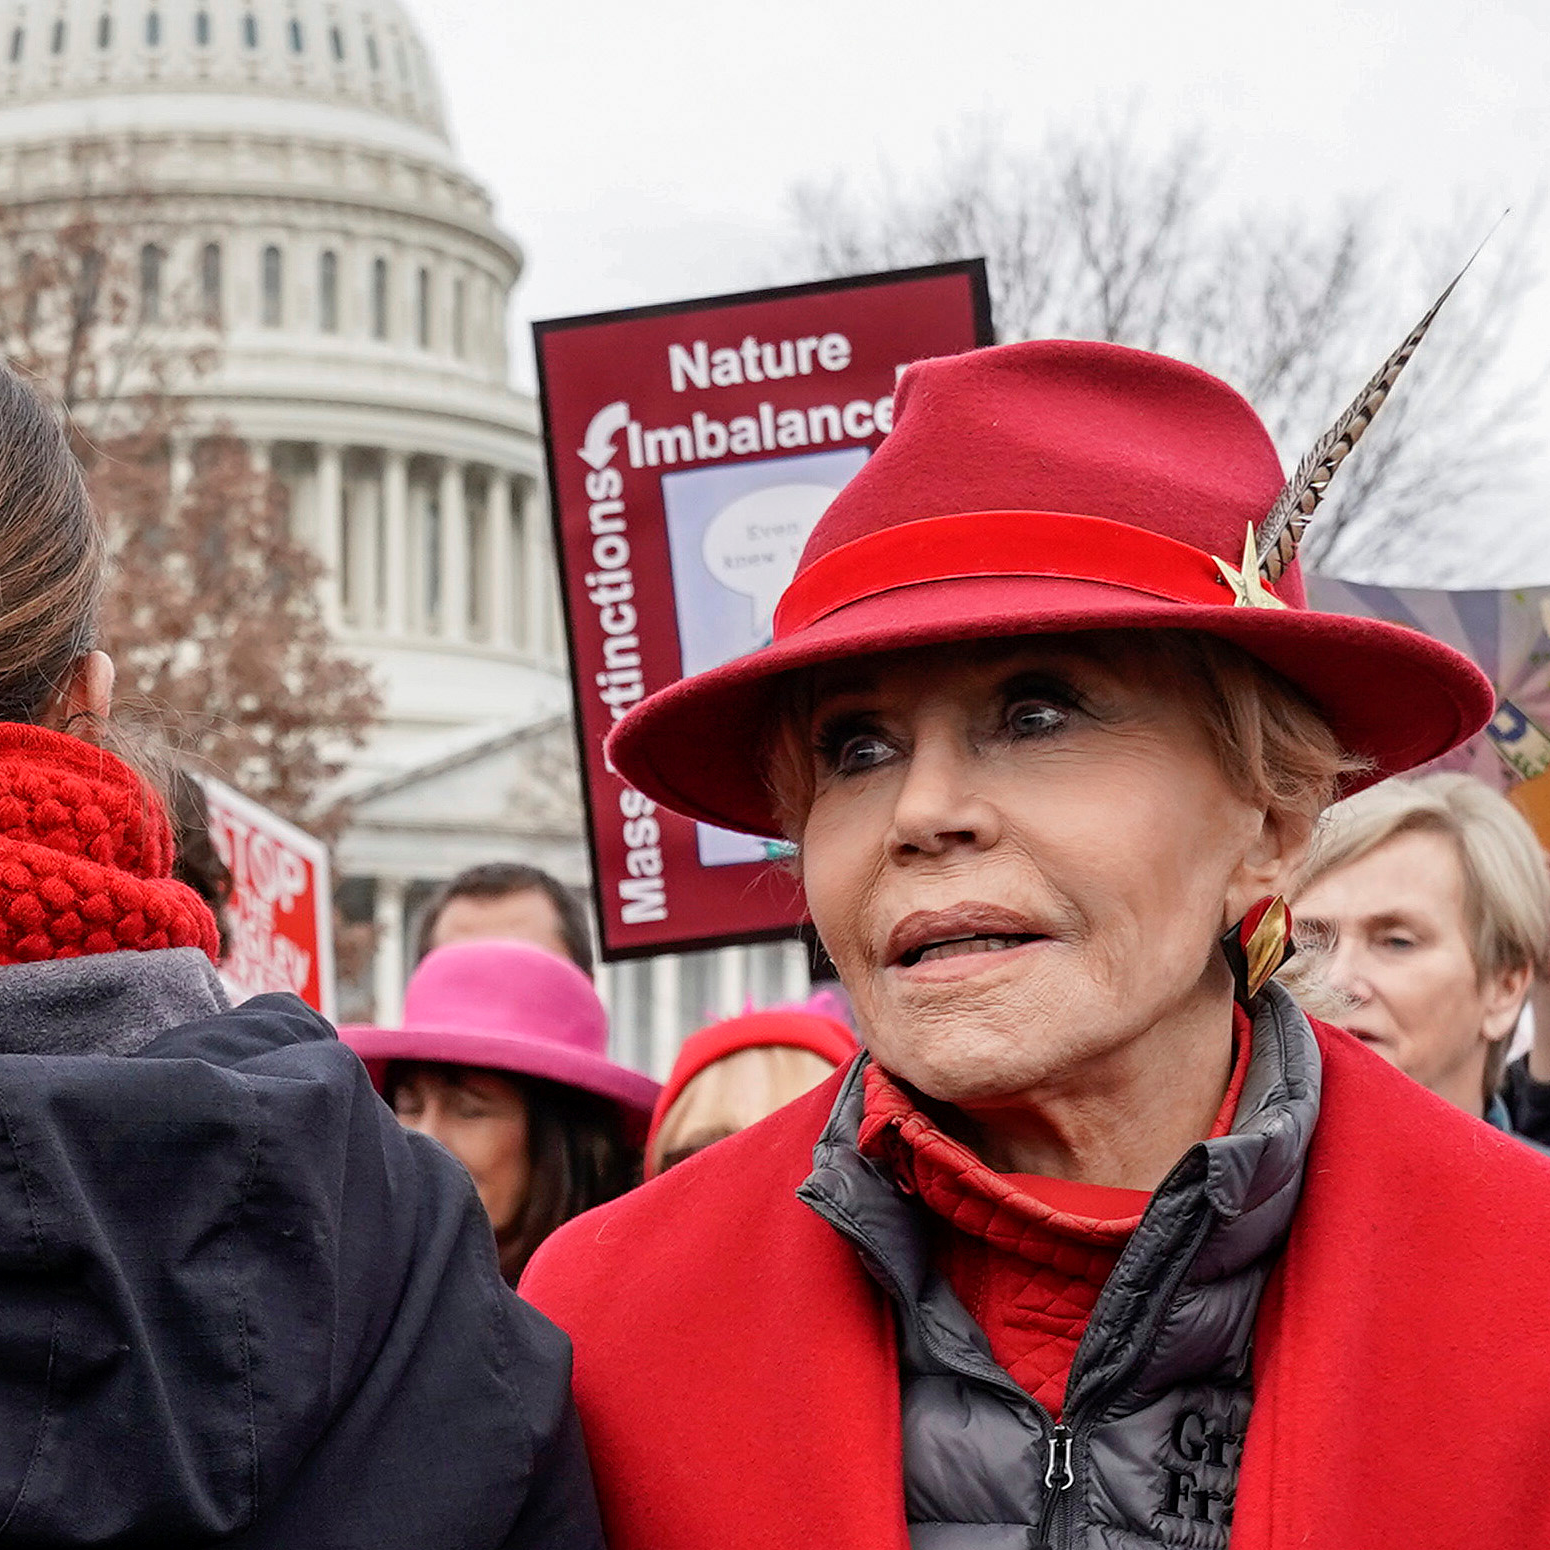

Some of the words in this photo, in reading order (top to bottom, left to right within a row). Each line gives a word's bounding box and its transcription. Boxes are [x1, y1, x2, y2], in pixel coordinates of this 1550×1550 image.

[667, 333, 852, 392] Nature
[584, 466, 646, 773] tinctions
[618, 787, 669, 925] Mass
[1170, 1406, 1245, 1469] Gr
[1151, 1465, 1235, 1527] Fr
